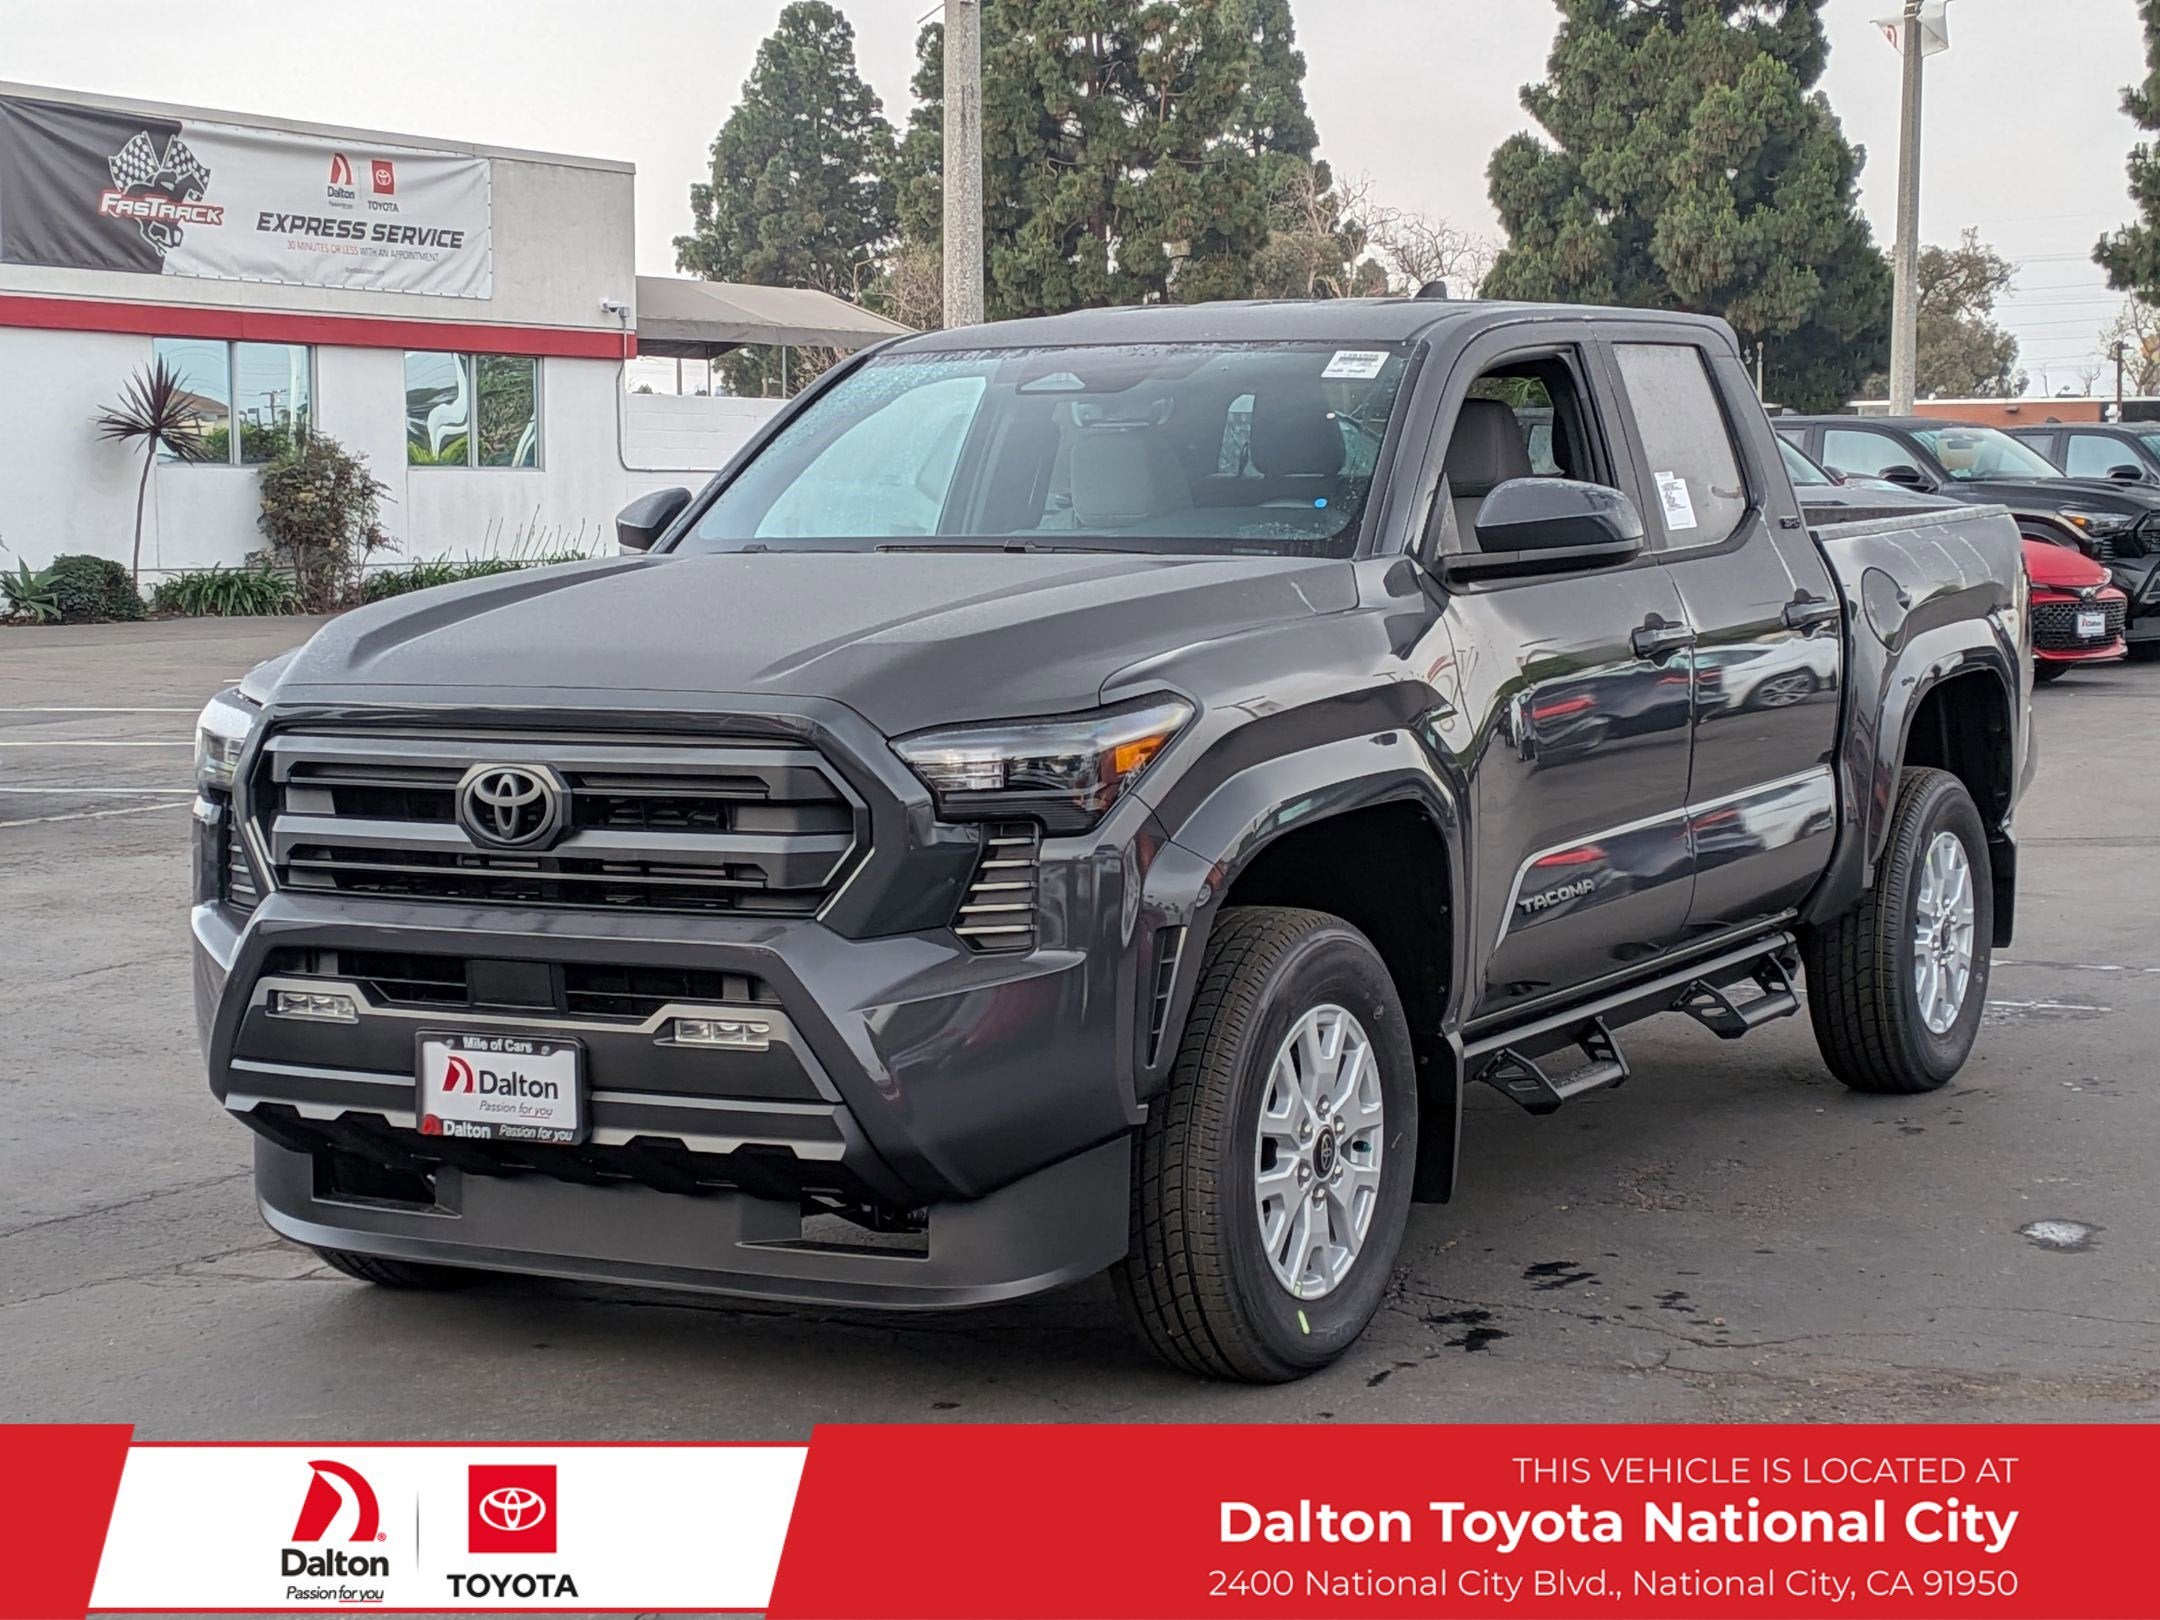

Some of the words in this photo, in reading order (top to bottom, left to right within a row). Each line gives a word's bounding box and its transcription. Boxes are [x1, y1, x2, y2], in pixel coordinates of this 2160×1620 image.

[327, 186, 355, 199] Dalton
[368, 200, 399, 212] TOYOTA
[256, 211, 368, 240] EXPRESS
[371, 224, 465, 249] SERVICE
[287, 240, 296, 250] 30
[297, 241, 329, 253] MINUTES
[331, 244, 341, 254] OR
[342, 245, 359, 255] LESS
[360, 247, 378, 257] WITH
[379, 249, 389, 257] AN
[391, 250, 439, 262] APPOINTMENT
[1519, 878, 1596, 913] TACOMA
[463, 1036, 487, 1050] Mile
[490, 1038, 503, 1051] of
[504, 1039, 533, 1053] Cars
[479, 1070, 558, 1099] Dalton
[479, 1100, 516, 1113] Passion
[518, 1103, 533, 1115] for
[534, 1107, 553, 1116] you
[443, 1120, 491, 1139] Dalton
[499, 1124, 535, 1139] Passion
[536, 1127, 552, 1140] for
[553, 1130, 573, 1142] you
